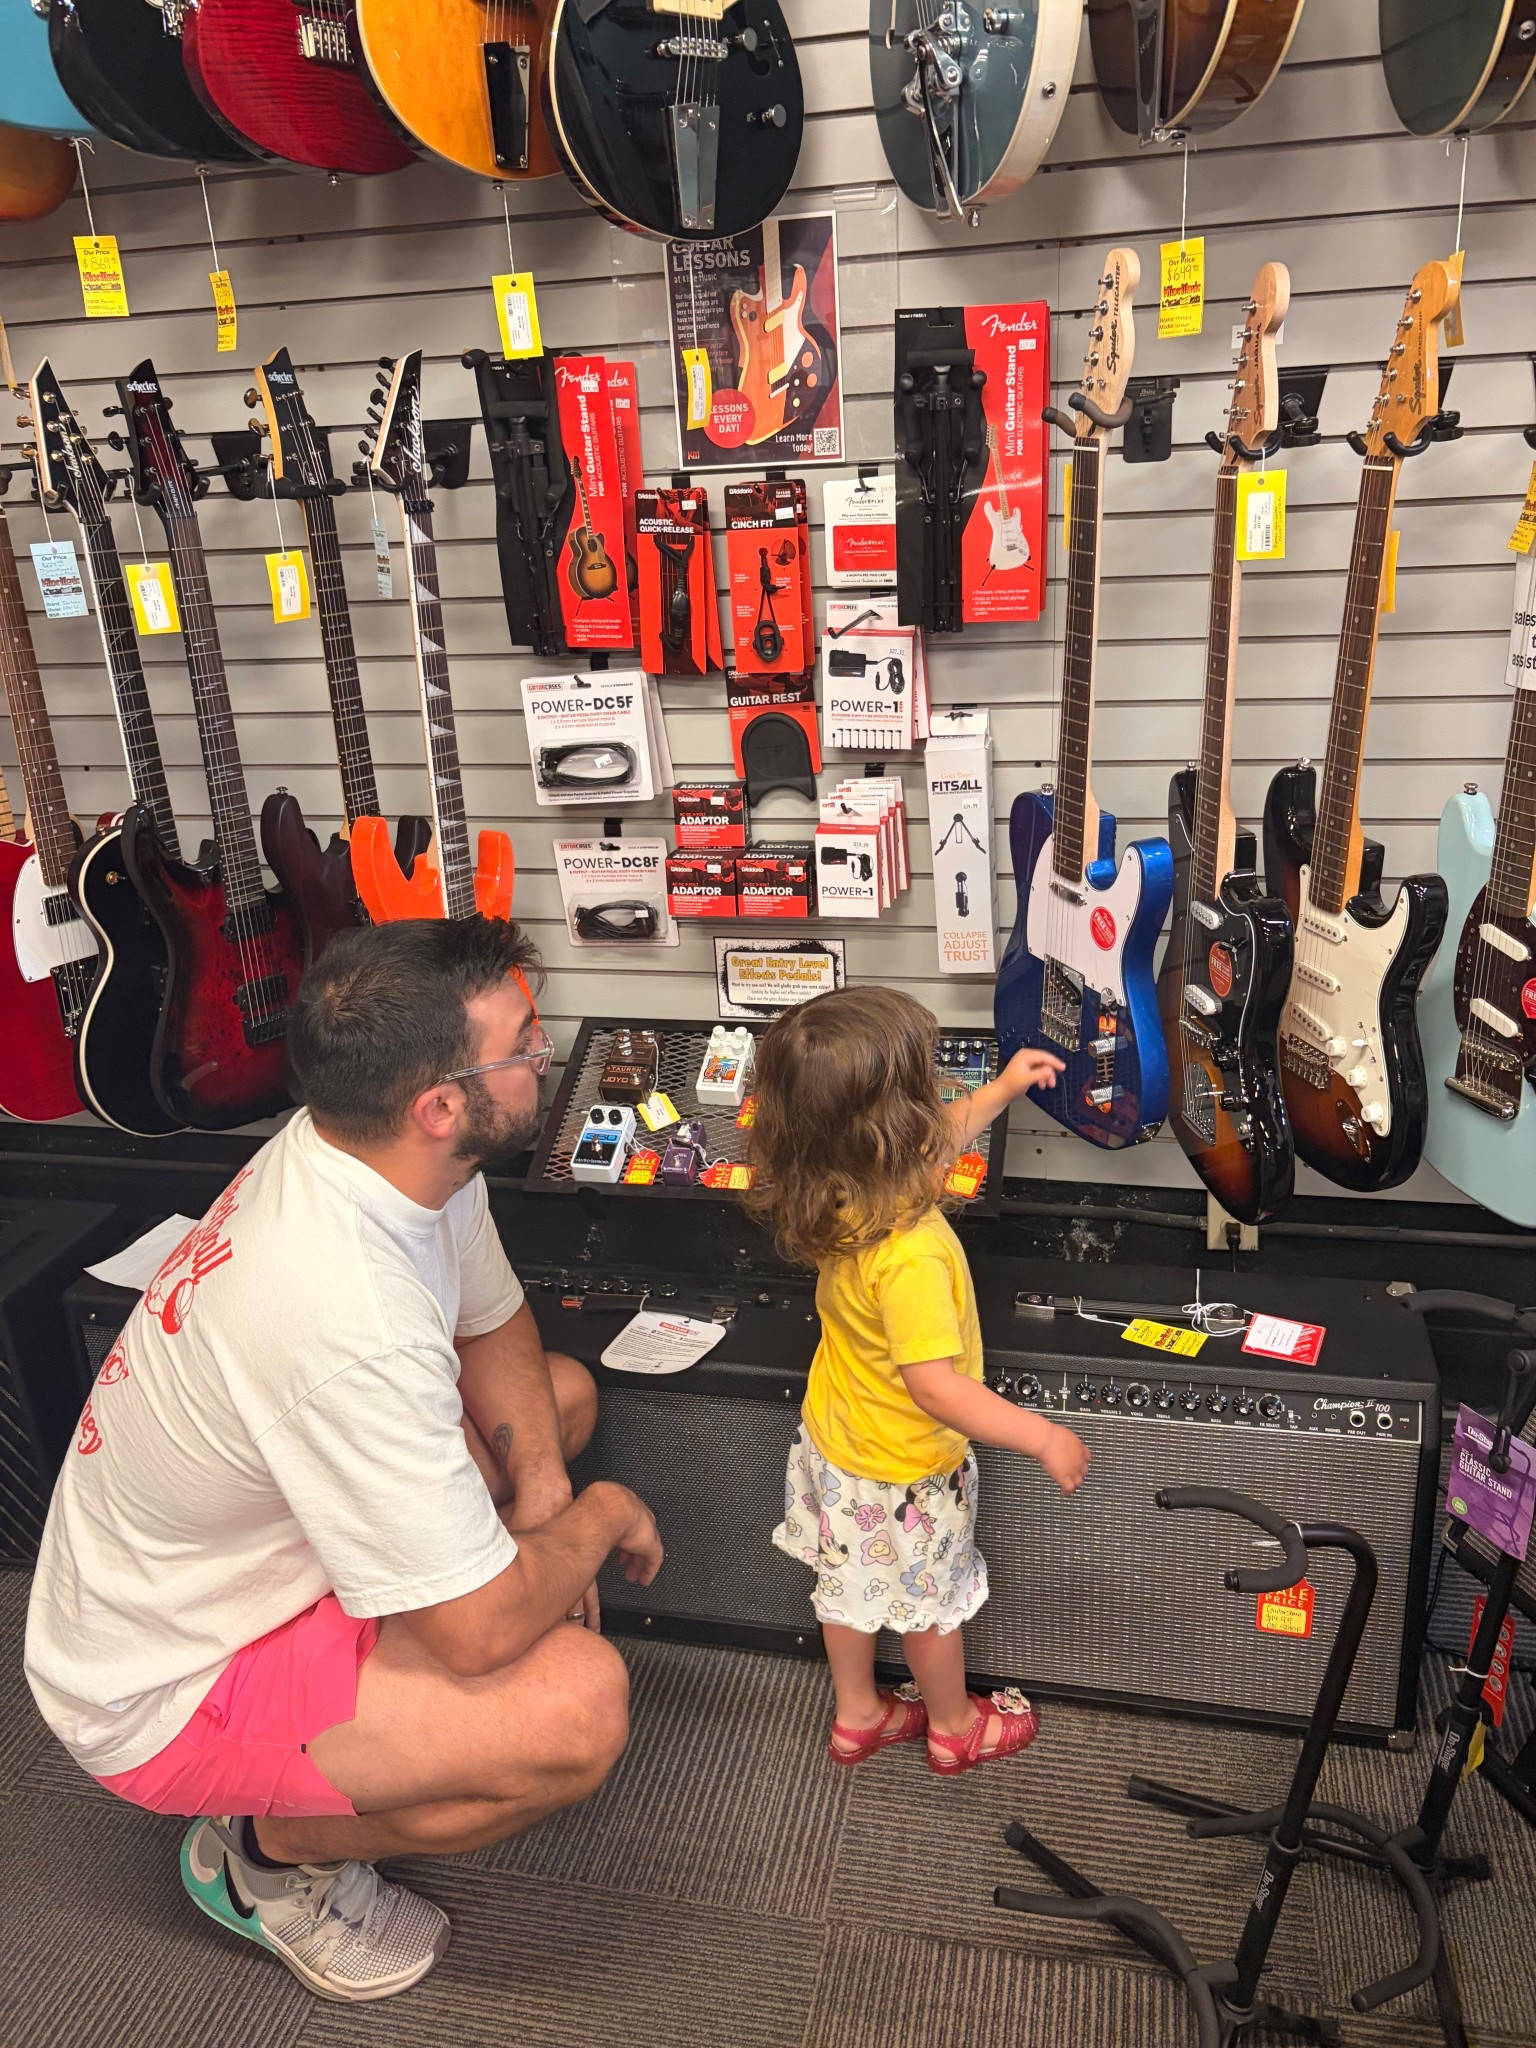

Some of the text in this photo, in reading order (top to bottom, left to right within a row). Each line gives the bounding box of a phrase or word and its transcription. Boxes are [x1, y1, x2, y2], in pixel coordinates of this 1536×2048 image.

[673, 249, 751, 272] LESSONS
[982, 312, 1038, 337] Fender
[1107, 319, 1121, 375] Squier
[555, 365, 600, 387] Fender
[1409, 359, 1426, 415] Squier
[1006, 345, 1016, 456] Mini Guitar Stand
[714, 414, 742, 424] EVERY
[403, 385, 422, 473] Jackson
[590, 413, 599, 443] GUITARS
[616, 416, 624, 446] GUITARS
[718, 424, 740, 433] DAY!
[577, 395, 598, 497] Mini Guitar Stand
[775, 433, 813, 443] Learn More
[59, 423, 82, 478] Jackson
[793, 443, 813, 453] Today!
[593, 446, 603, 480] ACOUSTIC
[619, 447, 627, 480] ACOUSTIC
[640, 526, 694, 534] QUICK-RELEASE
[731, 520, 774, 529] CINCH FIT
[532, 696, 634, 714] POWER-DC5F
[730, 693, 801, 707] GUITAR REST
[831, 700, 898, 713] POWER-1
[932, 780, 982, 792] FITSALL
[680, 816, 730, 825] ADAPTOR
[564, 857, 660, 870] POWER-DC8F
[672, 887, 722, 896] ADAPTOR
[743, 887, 793, 896] ADAPTOR
[822, 886, 874, 896] POWER-1
[1094, 910, 1106, 930] FREE
[943, 931, 987, 940] COLLAPSE
[944, 940, 988, 950] ADJUST
[731, 956, 829, 971] Great Entry Level
[944, 950, 989, 962] TRUST
[1211, 955, 1222, 972] FREE
[739, 968, 822, 981] Effects Pedals!
[955, 1159, 984, 1174] SALE
[711, 1166, 726, 1188] SALE
[722, 1168, 731, 1187] PRICE
[1313, 1398, 1363, 1411] Champion
[1375, 1404, 1391, 1413] 100
[1467, 1425, 1493, 1448] On-Stag
[1460, 1452, 1492, 1477] CLASSIC
[1459, 1460, 1487, 1483] GUITAR
[1488, 1477, 1512, 1500] STAND
[1265, 1594, 1304, 1608] PRICE
[1267, 1587, 1309, 1602] ALE
[1440, 1731, 1461, 1771] On-Stage
[1255, 1869, 1274, 1910] On-Stage
